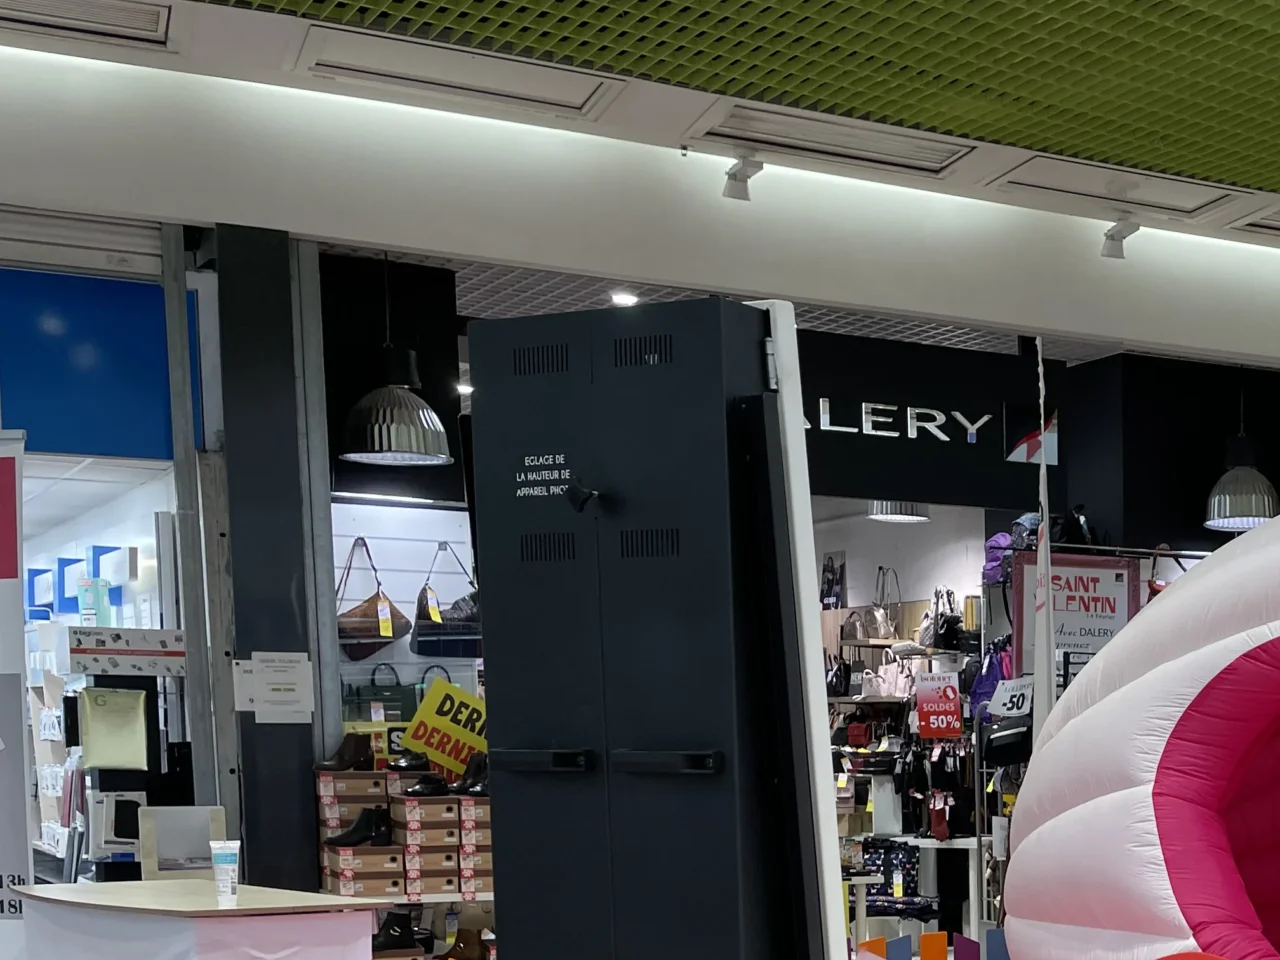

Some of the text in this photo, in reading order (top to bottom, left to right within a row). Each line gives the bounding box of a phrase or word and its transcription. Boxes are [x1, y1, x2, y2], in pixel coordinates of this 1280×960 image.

[804, 398, 993, 443] LERY
[524, 454, 565, 466] EGLAGE DE
[516, 469, 570, 482] LA HAUTEUR DE
[516, 486, 549, 497] APPAREIL
[1051, 575, 1100, 593] SAINT
[1053, 594, 1116, 613] LENTIN
[1054, 623, 1116, 638] Avec DALERY
[1055, 641, 1090, 650] prenez
[923, 703, 955, 711] SOLDES
[930, 714, 960, 729] 50%
[411, 720, 479, 767] DERNI
